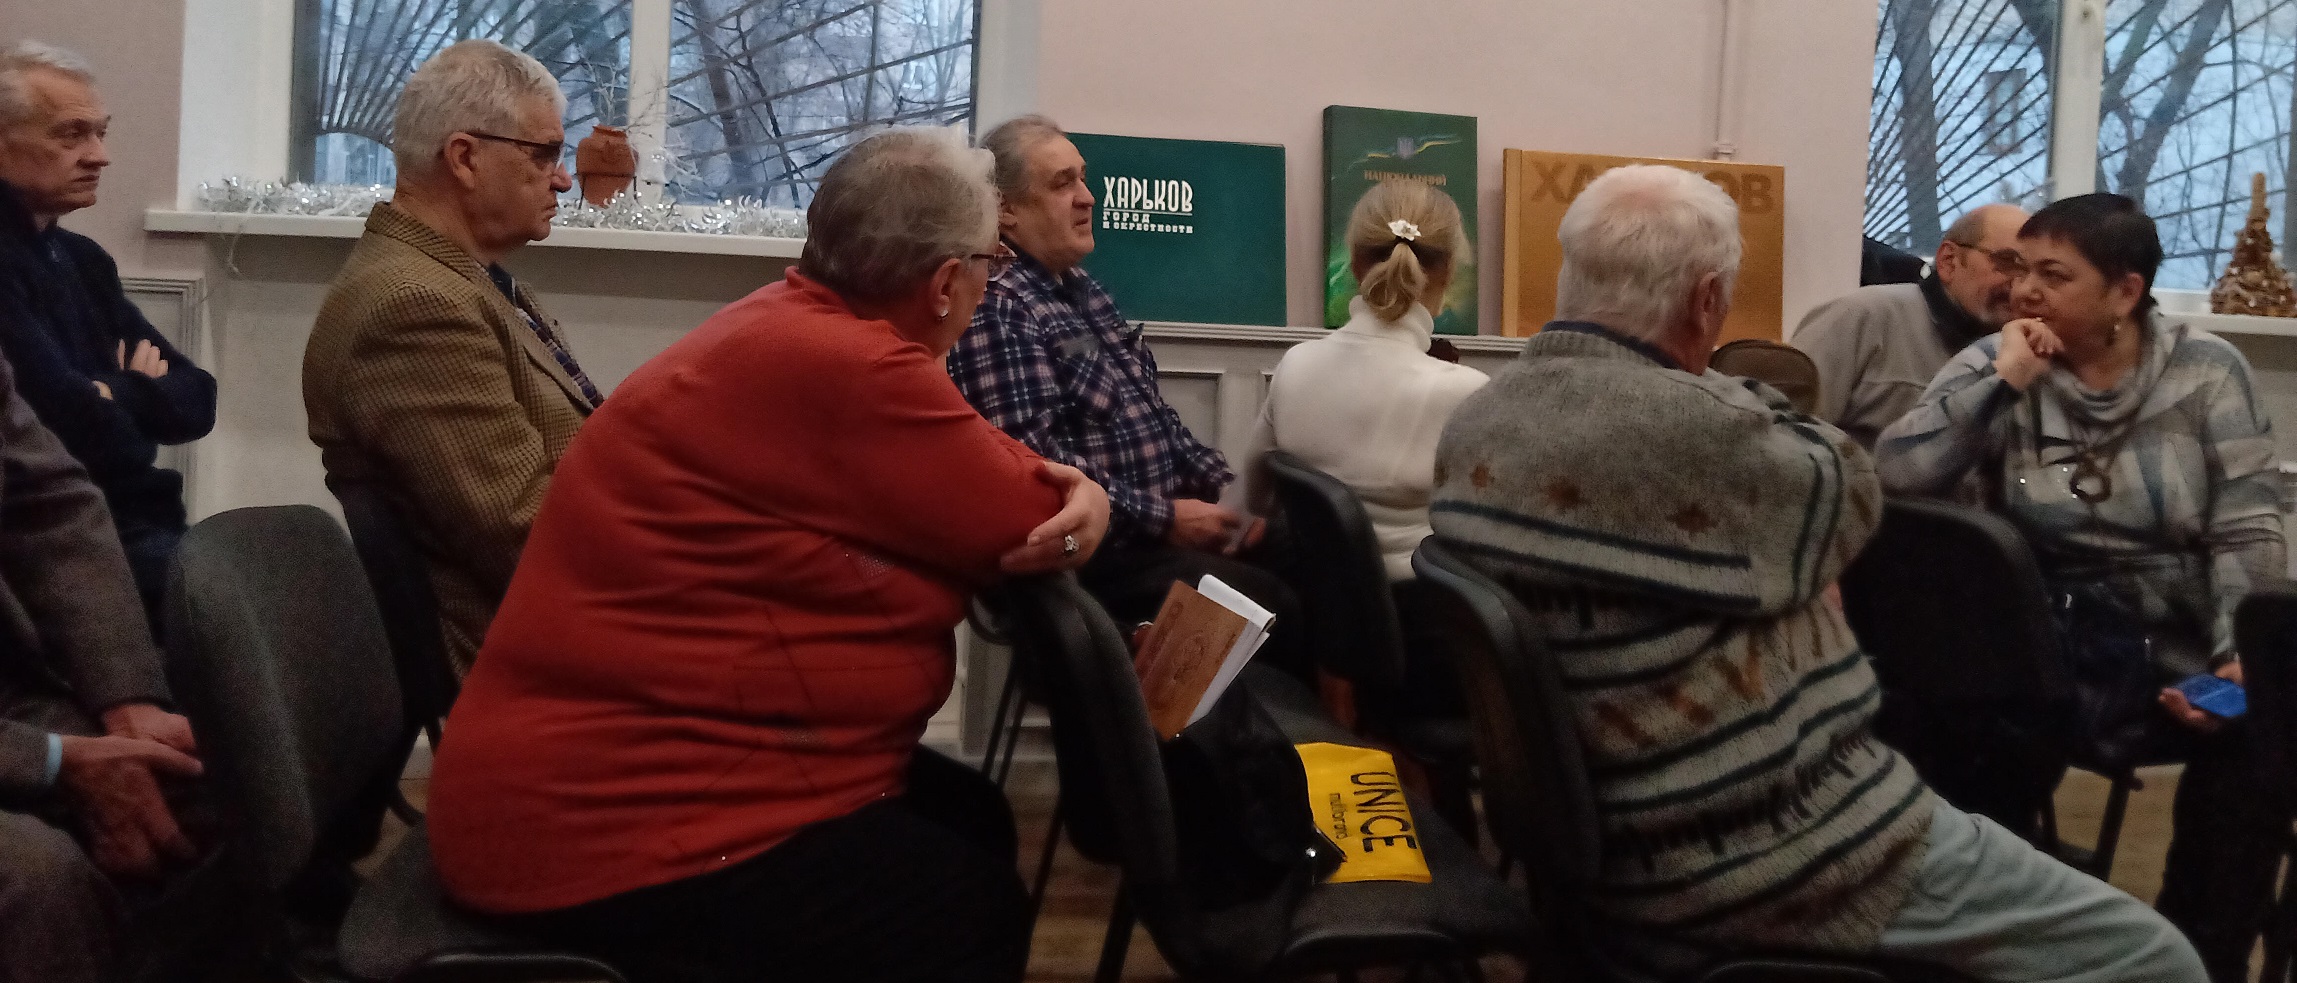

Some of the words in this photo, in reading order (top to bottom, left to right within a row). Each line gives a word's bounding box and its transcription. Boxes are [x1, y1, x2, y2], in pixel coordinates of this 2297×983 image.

[1103, 176, 1194, 213] ХАРЬКОВ
[1102, 221, 1110, 229] И
[1113, 222, 1194, 234] ОКРЕСТНОСТИ
[1103, 211, 1150, 224] ГОРОД
[1350, 771, 1418, 853] UNICE
